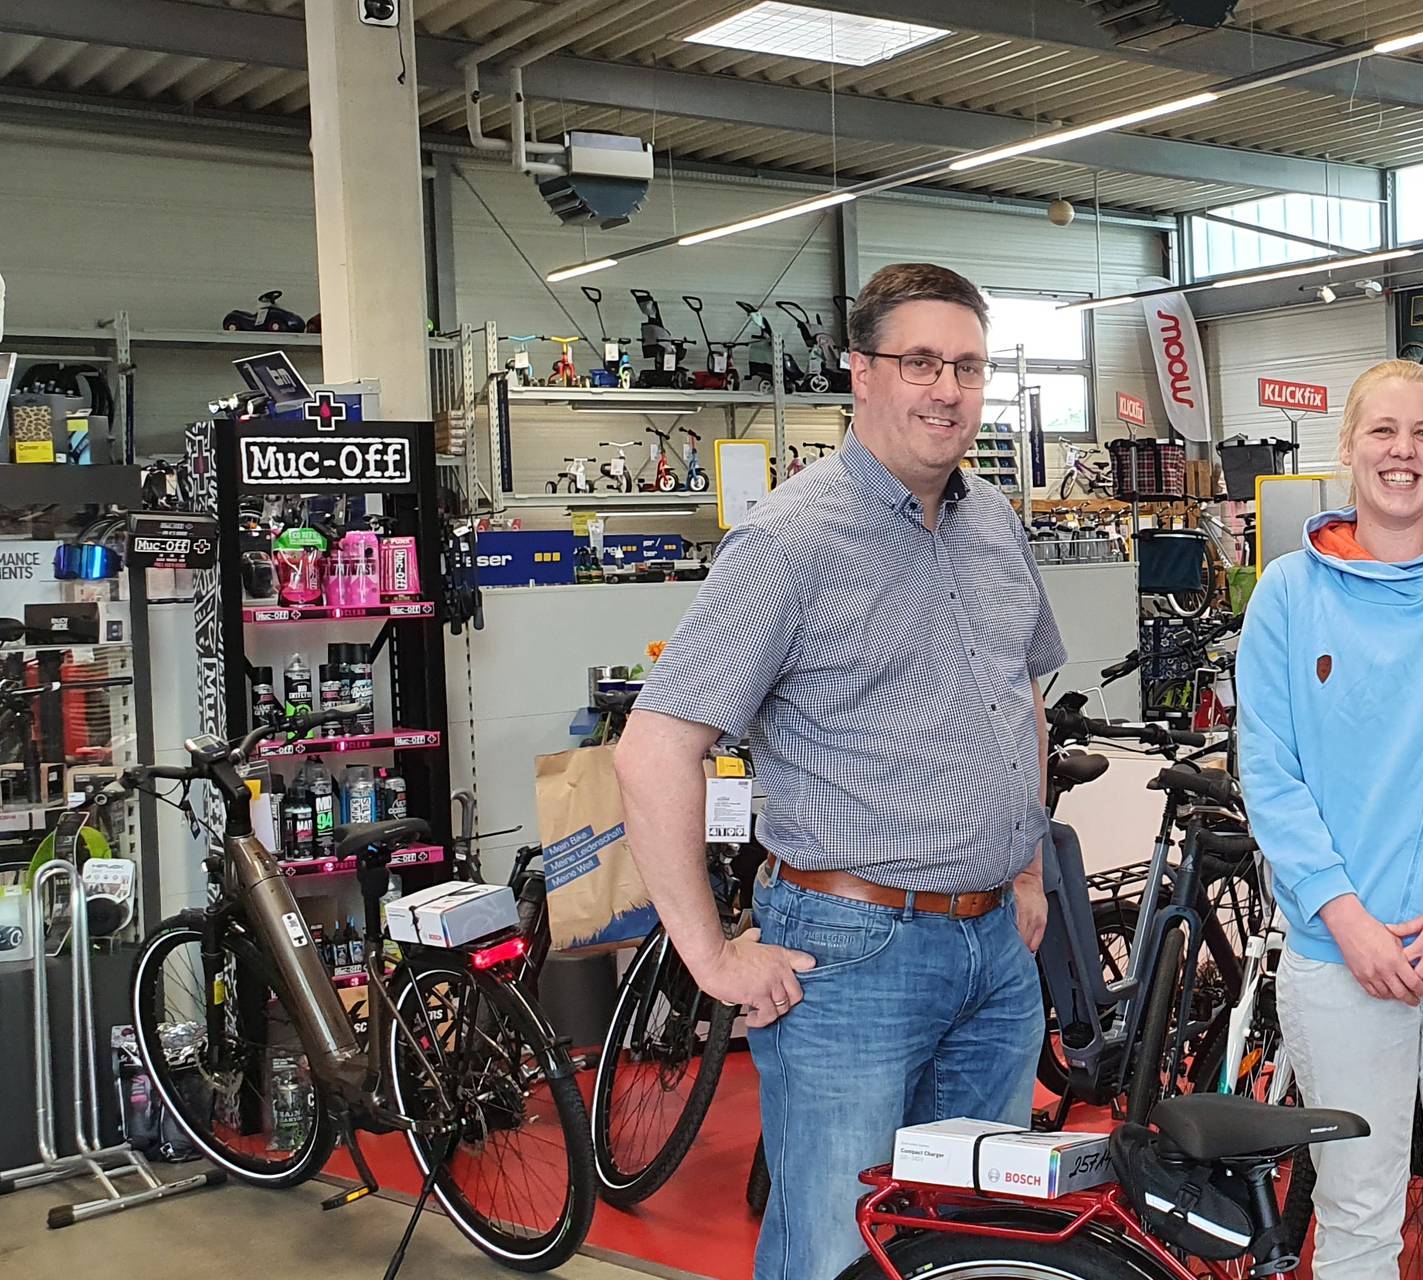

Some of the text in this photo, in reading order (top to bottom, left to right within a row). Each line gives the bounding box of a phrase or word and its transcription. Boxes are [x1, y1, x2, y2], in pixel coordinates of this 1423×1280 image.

[1265, 384, 1322, 406] KLICKfix
[250, 444, 402, 477] Muc-Off
[137, 540, 188, 551] Muc-Off
[256, 611, 289, 620] Muc-Off
[390, 605, 420, 614] Muc-Off
[549, 840, 570, 856] Mein
[550, 827, 624, 871] Meine Leidenschaft
[552, 870, 577, 887] Meine
[901, 1147, 945, 1159] Compact Charger
[1005, 1171, 1041, 1187] BOSCH
